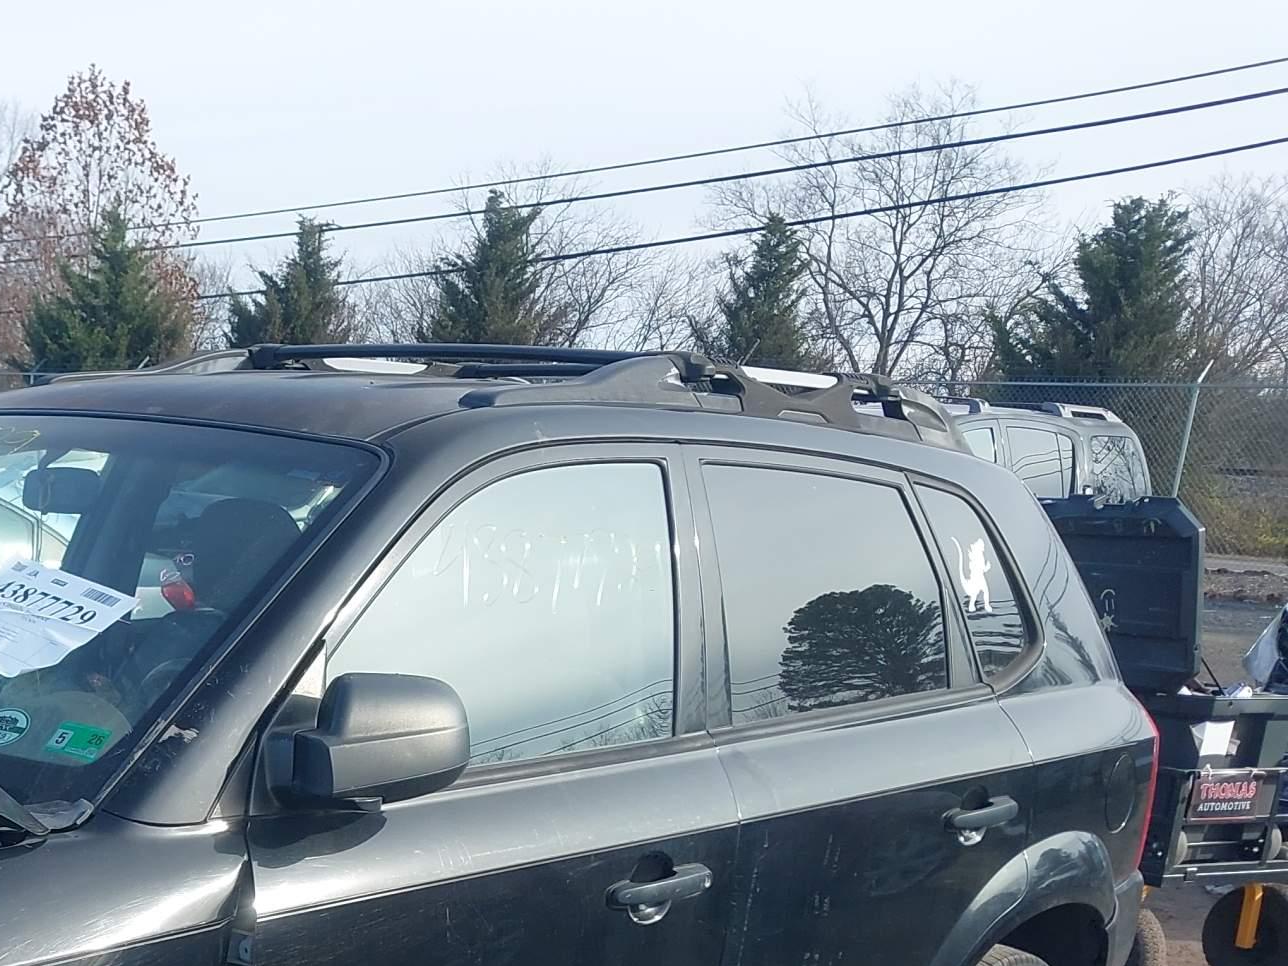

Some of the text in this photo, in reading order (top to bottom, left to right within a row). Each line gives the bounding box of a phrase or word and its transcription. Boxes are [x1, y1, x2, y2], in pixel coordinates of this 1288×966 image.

[55, 732, 105, 746] 5 26
[1200, 781, 1257, 800] THOMAS
[1197, 801, 1251, 811] AUTOMOTIVE
